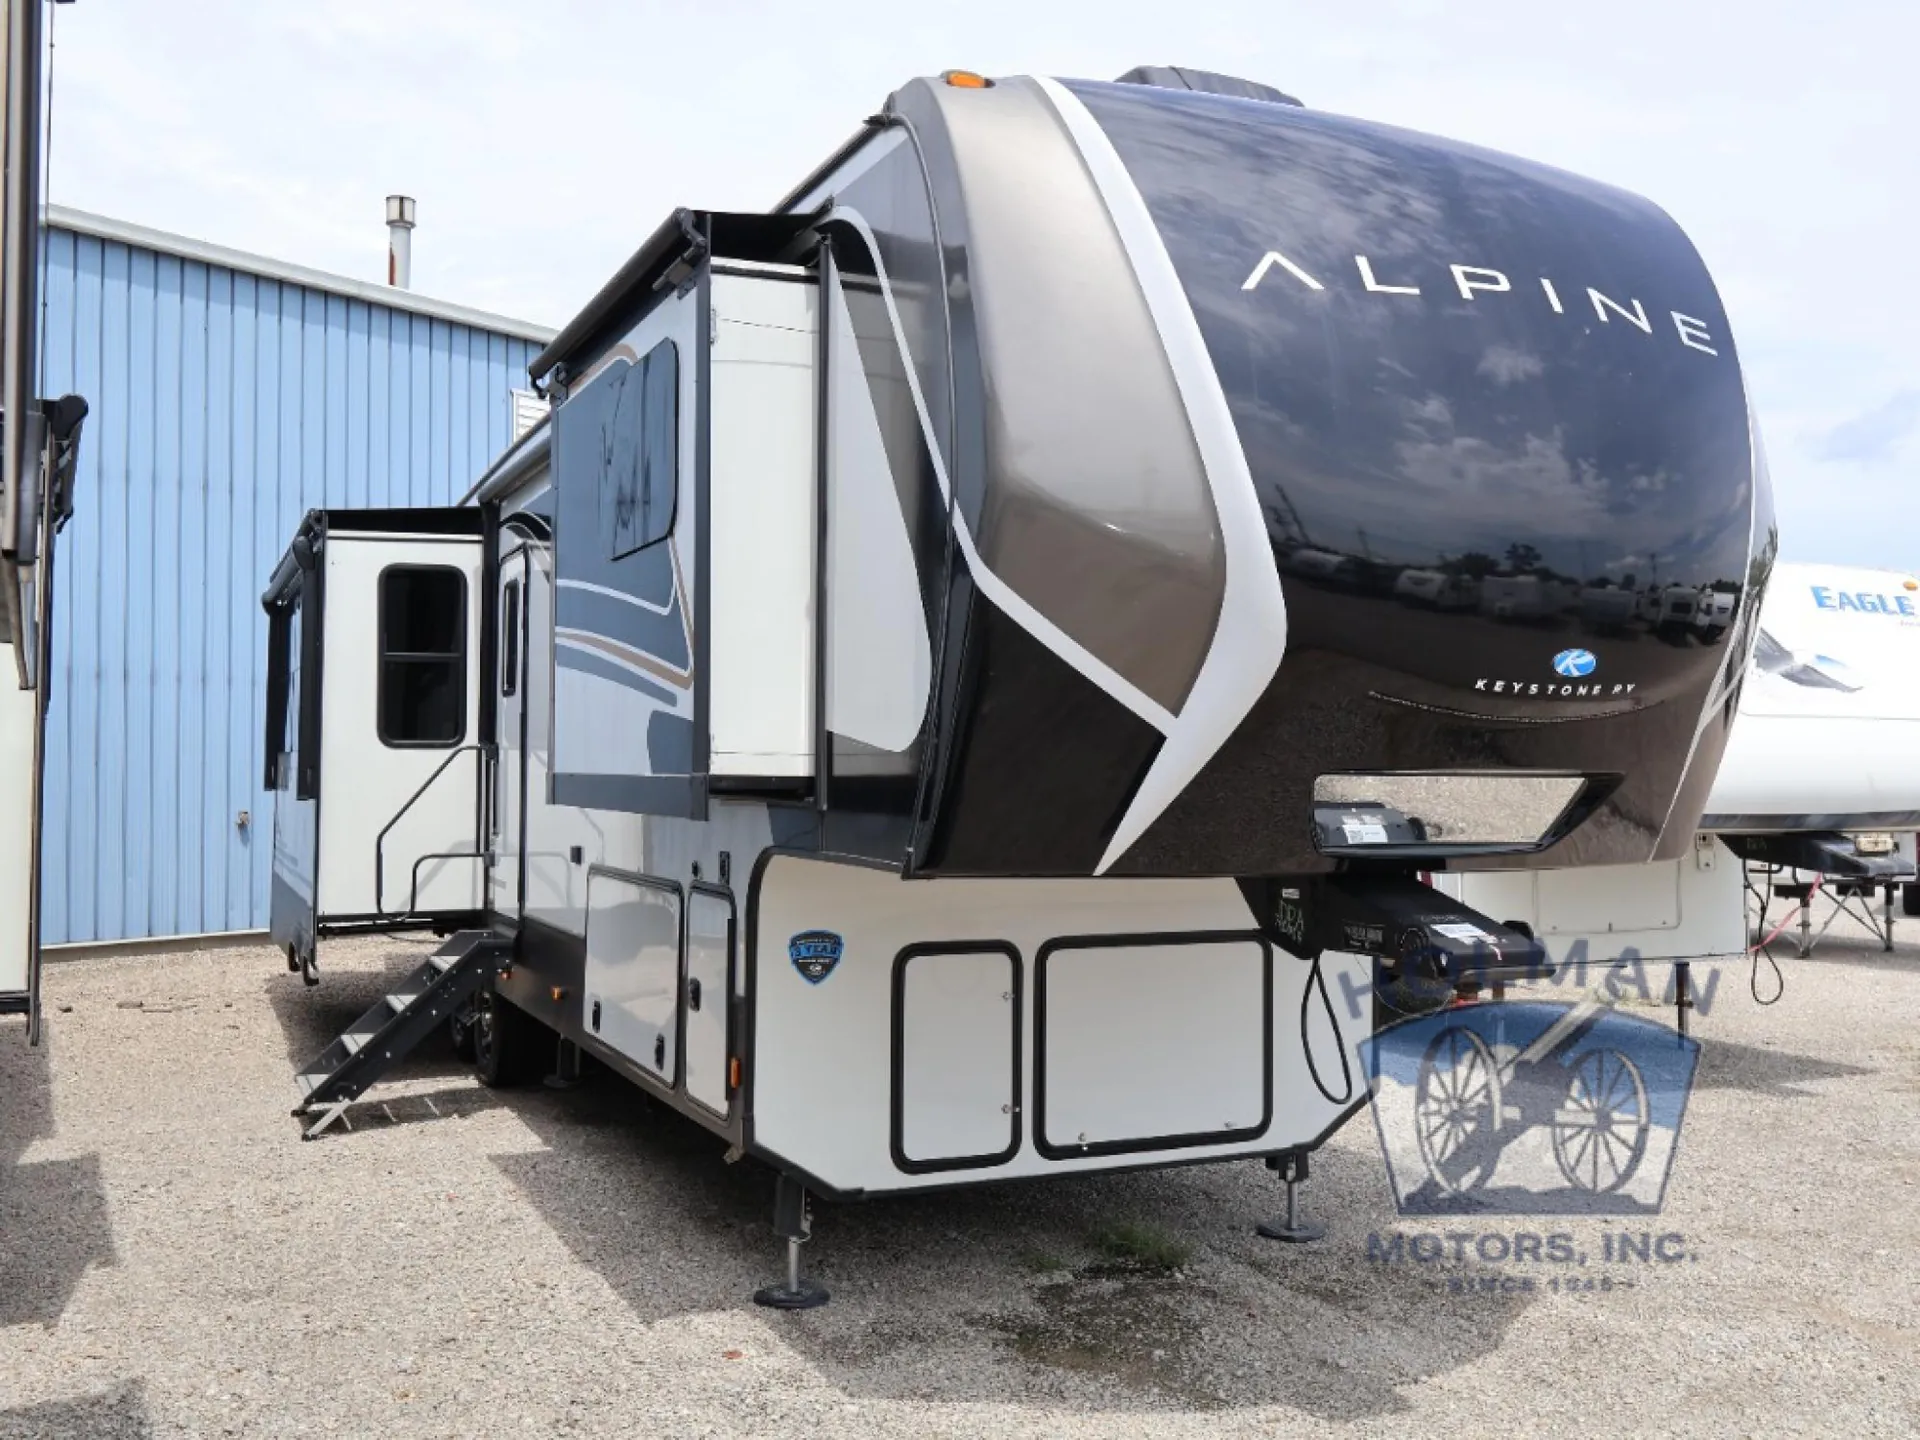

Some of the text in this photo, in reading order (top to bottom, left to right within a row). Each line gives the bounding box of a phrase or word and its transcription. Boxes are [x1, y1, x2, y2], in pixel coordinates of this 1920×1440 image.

[1241, 250, 1718, 357] ALPINE
[1810, 586, 1916, 616] EAGLE
[1475, 678, 1602, 696] KEYSTONE
